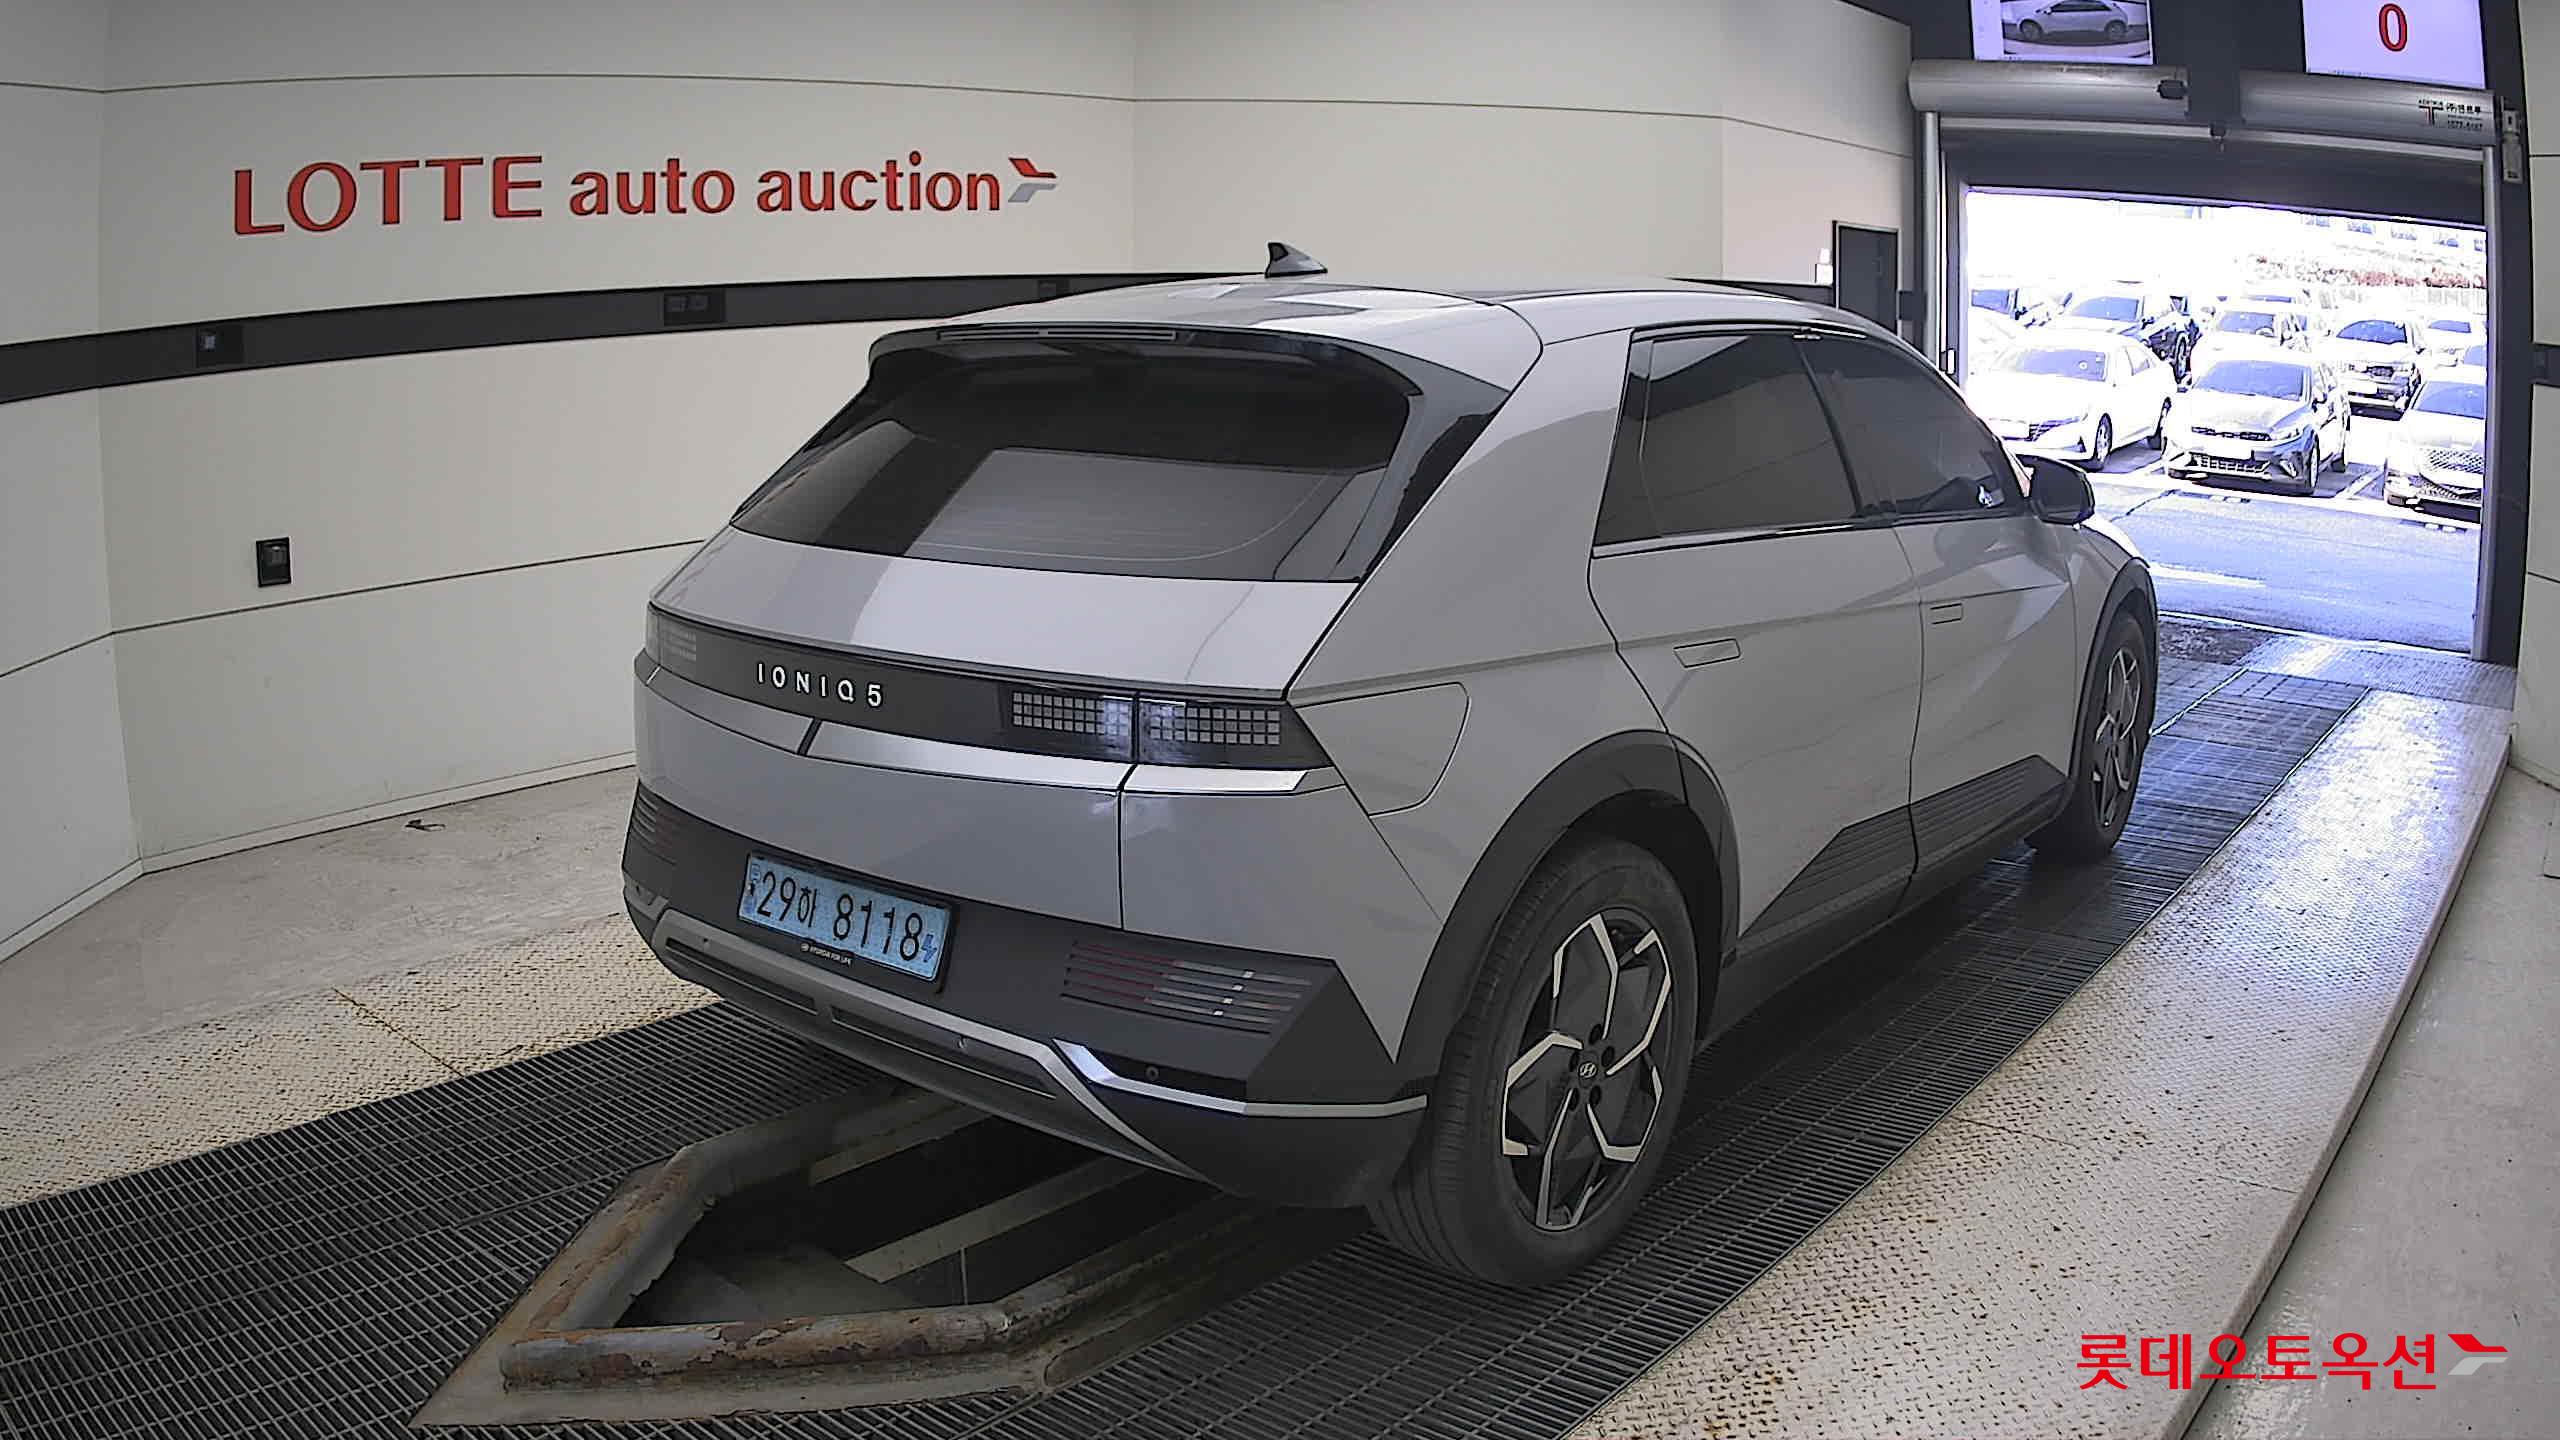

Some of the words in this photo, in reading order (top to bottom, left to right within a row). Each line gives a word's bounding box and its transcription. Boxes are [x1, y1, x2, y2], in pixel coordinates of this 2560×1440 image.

[2379, 3, 2408, 52] 0
[234, 155, 543, 235] LOTTE
[568, 158, 736, 216] auto
[756, 150, 1001, 214] auction
[757, 662, 855, 703] IONIQ
[867, 683, 882, 708] 5
[756, 870, 818, 928] 29하
[832, 892, 924, 962] 8118
